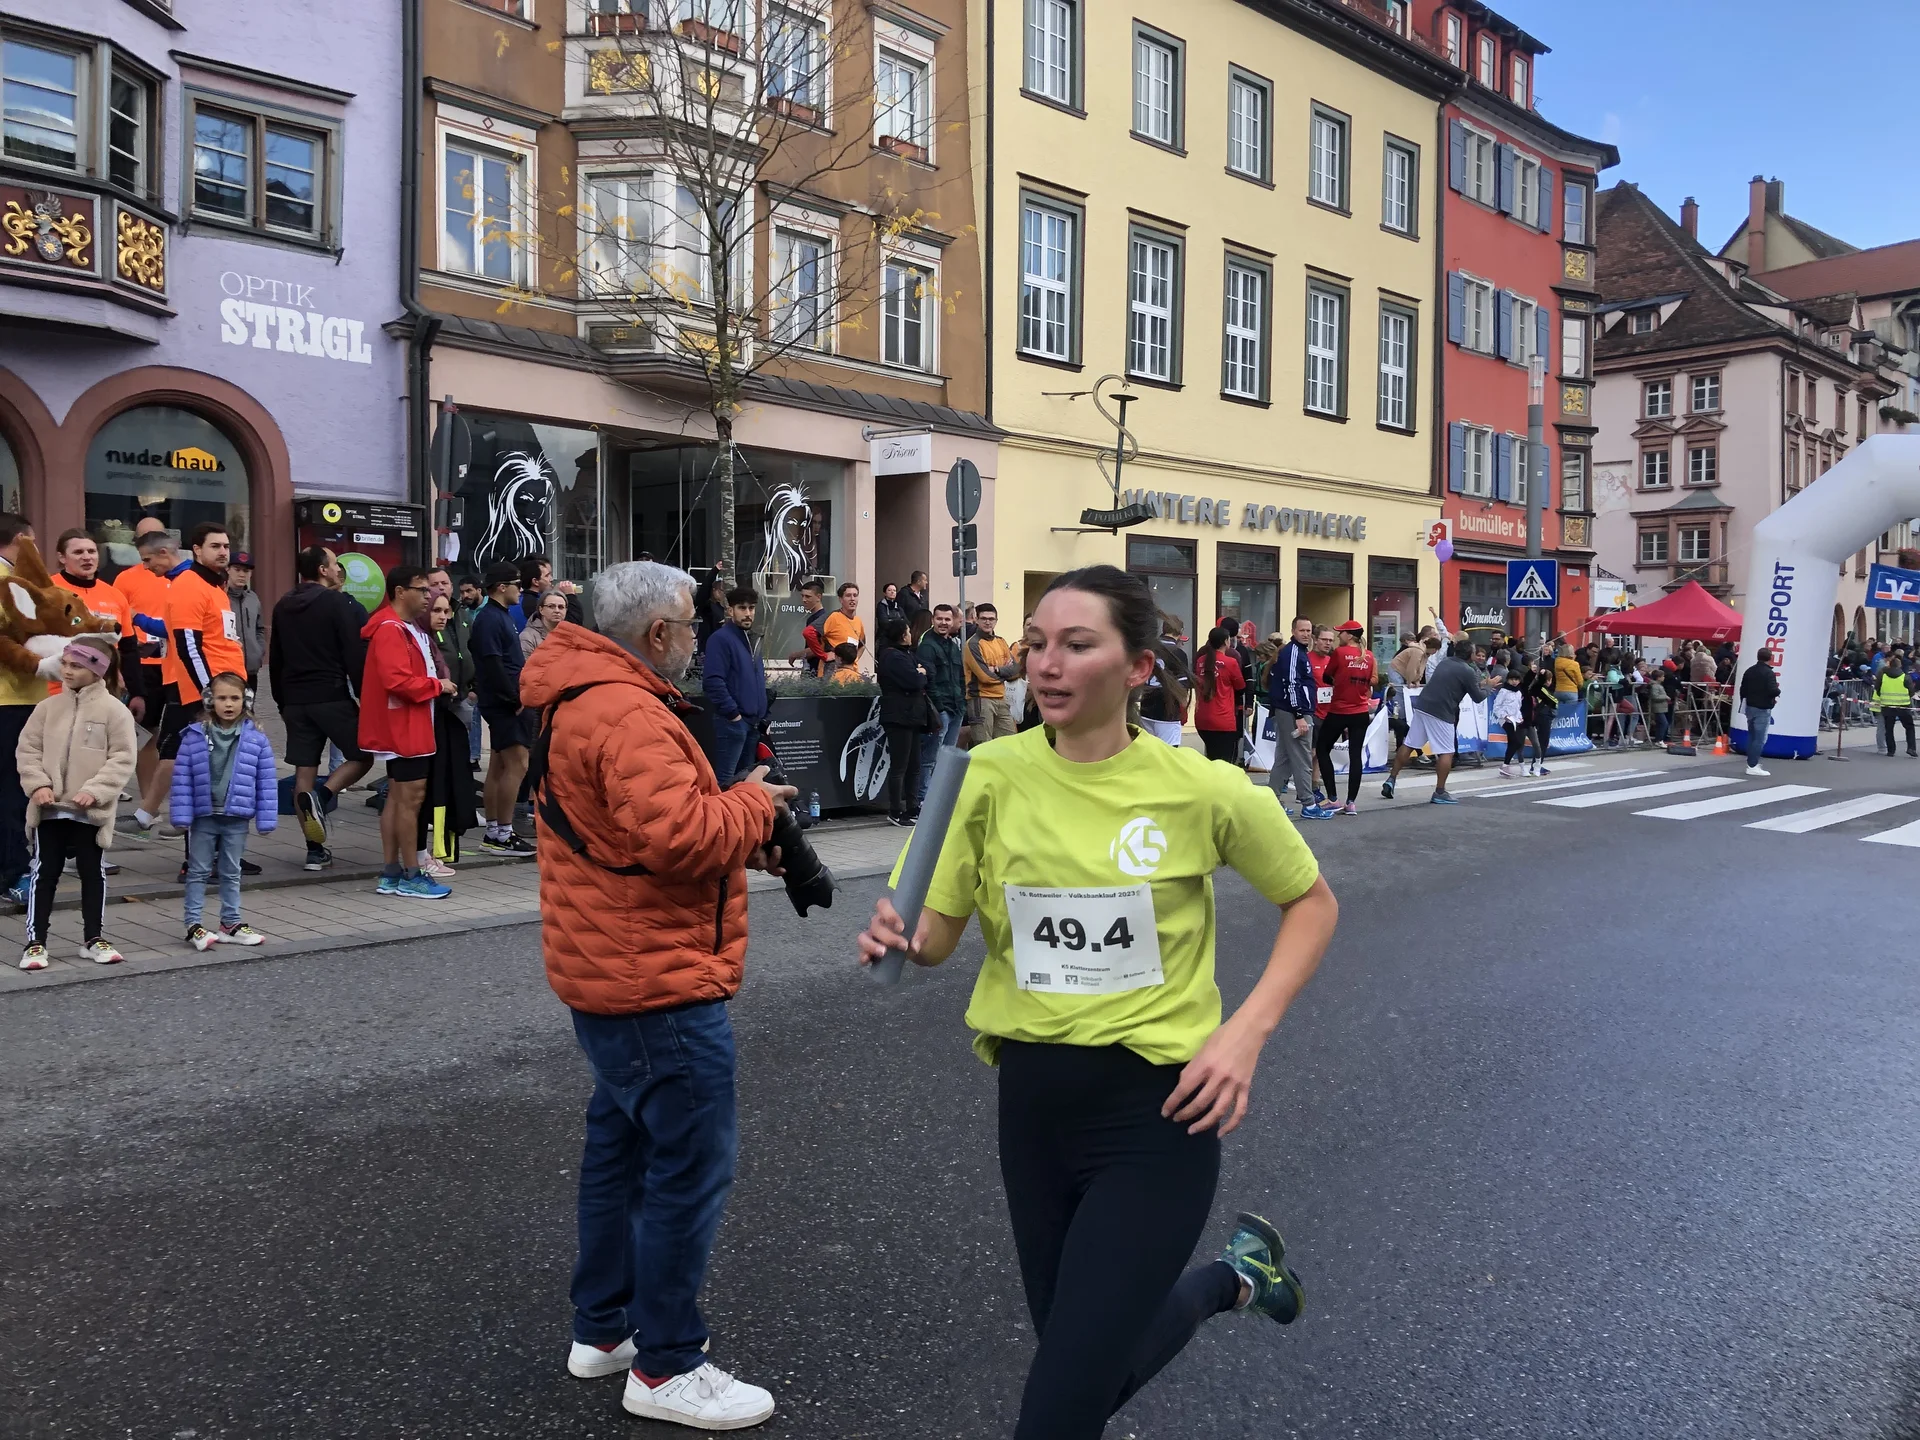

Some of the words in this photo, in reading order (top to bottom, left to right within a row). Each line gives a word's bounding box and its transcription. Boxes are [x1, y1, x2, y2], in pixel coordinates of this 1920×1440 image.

[220, 271, 316, 309] OPTIK
[220, 297, 372, 364] STRIGL
[105, 446, 226, 472] nudelhaus
[881, 440, 919, 460] Friseur
[1242, 502, 1367, 540] APOTHEKE
[1459, 509, 1514, 537] bumüller
[361, 535, 384, 543] brillen.de
[341, 583, 381, 593] rillen.de
[781, 605, 796, 613] 0741
[1113, 824, 1168, 869] K5
[1118, 890, 1136, 898] 2023
[1033, 916, 1134, 952] 49.4
[1070, 964, 1111, 972] Kletterzentrum
